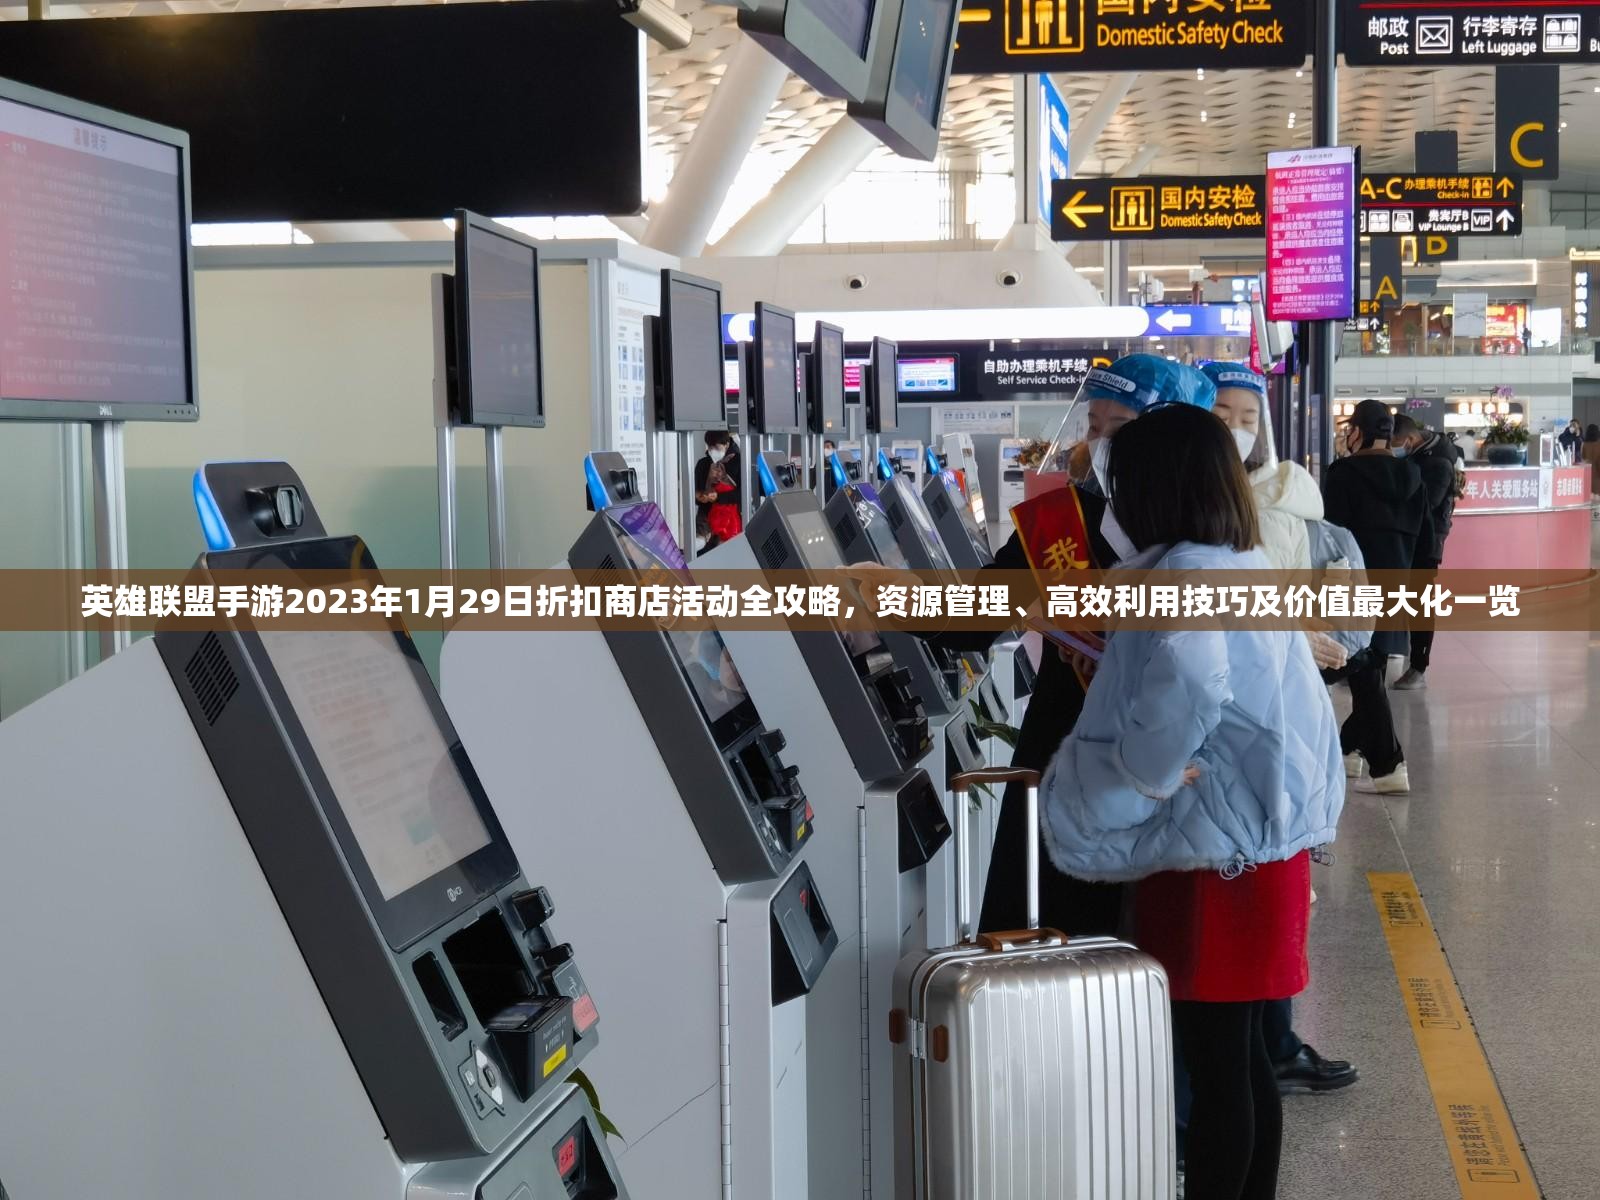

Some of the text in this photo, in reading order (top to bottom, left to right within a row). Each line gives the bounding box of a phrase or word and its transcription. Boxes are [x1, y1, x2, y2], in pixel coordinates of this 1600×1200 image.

[1097, 19, 1284, 49] Domestic Safety Check
[1368, 16, 1409, 38] 邮政
[1463, 16, 1538, 38] 行李寄存
[1380, 43, 1409, 55] Post
[1462, 40, 1537, 56] Left Luggage
[1510, 121, 1544, 168] C
[1360, 177, 1403, 200] A-C
[1404, 177, 1470, 190] 办理乘机手续
[1160, 184, 1256, 211] 国内安检
[1437, 190, 1470, 200] Check-in
[1160, 211, 1262, 230] Domestic Safety Check
[1418, 222, 1470, 233] VIP Lounge B
[1473, 214, 1490, 226] VIP
[1426, 235, 1449, 256] D
[1374, 275, 1399, 300] A
[984, 358, 1088, 374] 自助办理乘机手续
[997, 375, 1015, 385] Self
[1015, 375, 1047, 385] Service
[1042, 536, 1090, 581] 我
